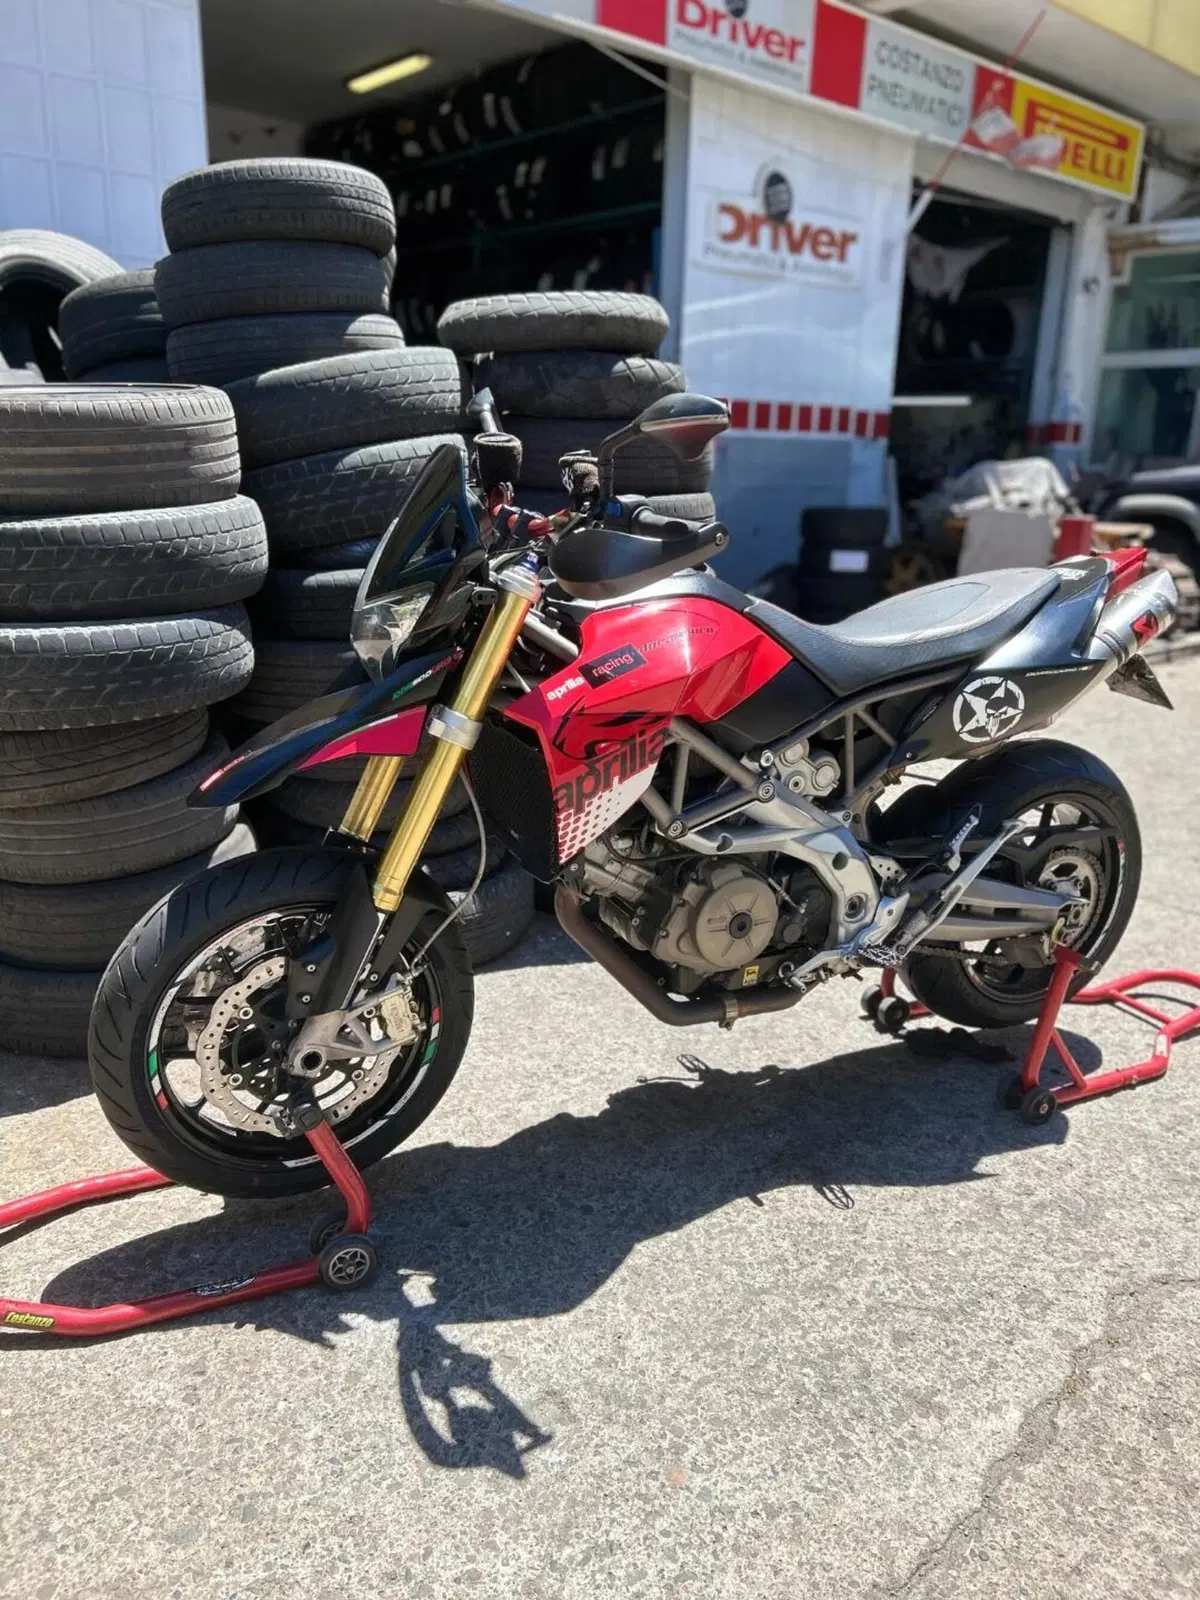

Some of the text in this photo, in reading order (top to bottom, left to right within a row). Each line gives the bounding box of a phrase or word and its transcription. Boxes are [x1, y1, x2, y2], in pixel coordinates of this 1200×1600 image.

[676, 0, 805, 62] Driver
[875, 40, 965, 93] COSTANZO
[717, 202, 858, 263] Driver
[546, 653, 634, 701] aprilia racing
[553, 728, 672, 817] aprilia
[5, 1311, 54, 1328] Costanzo
